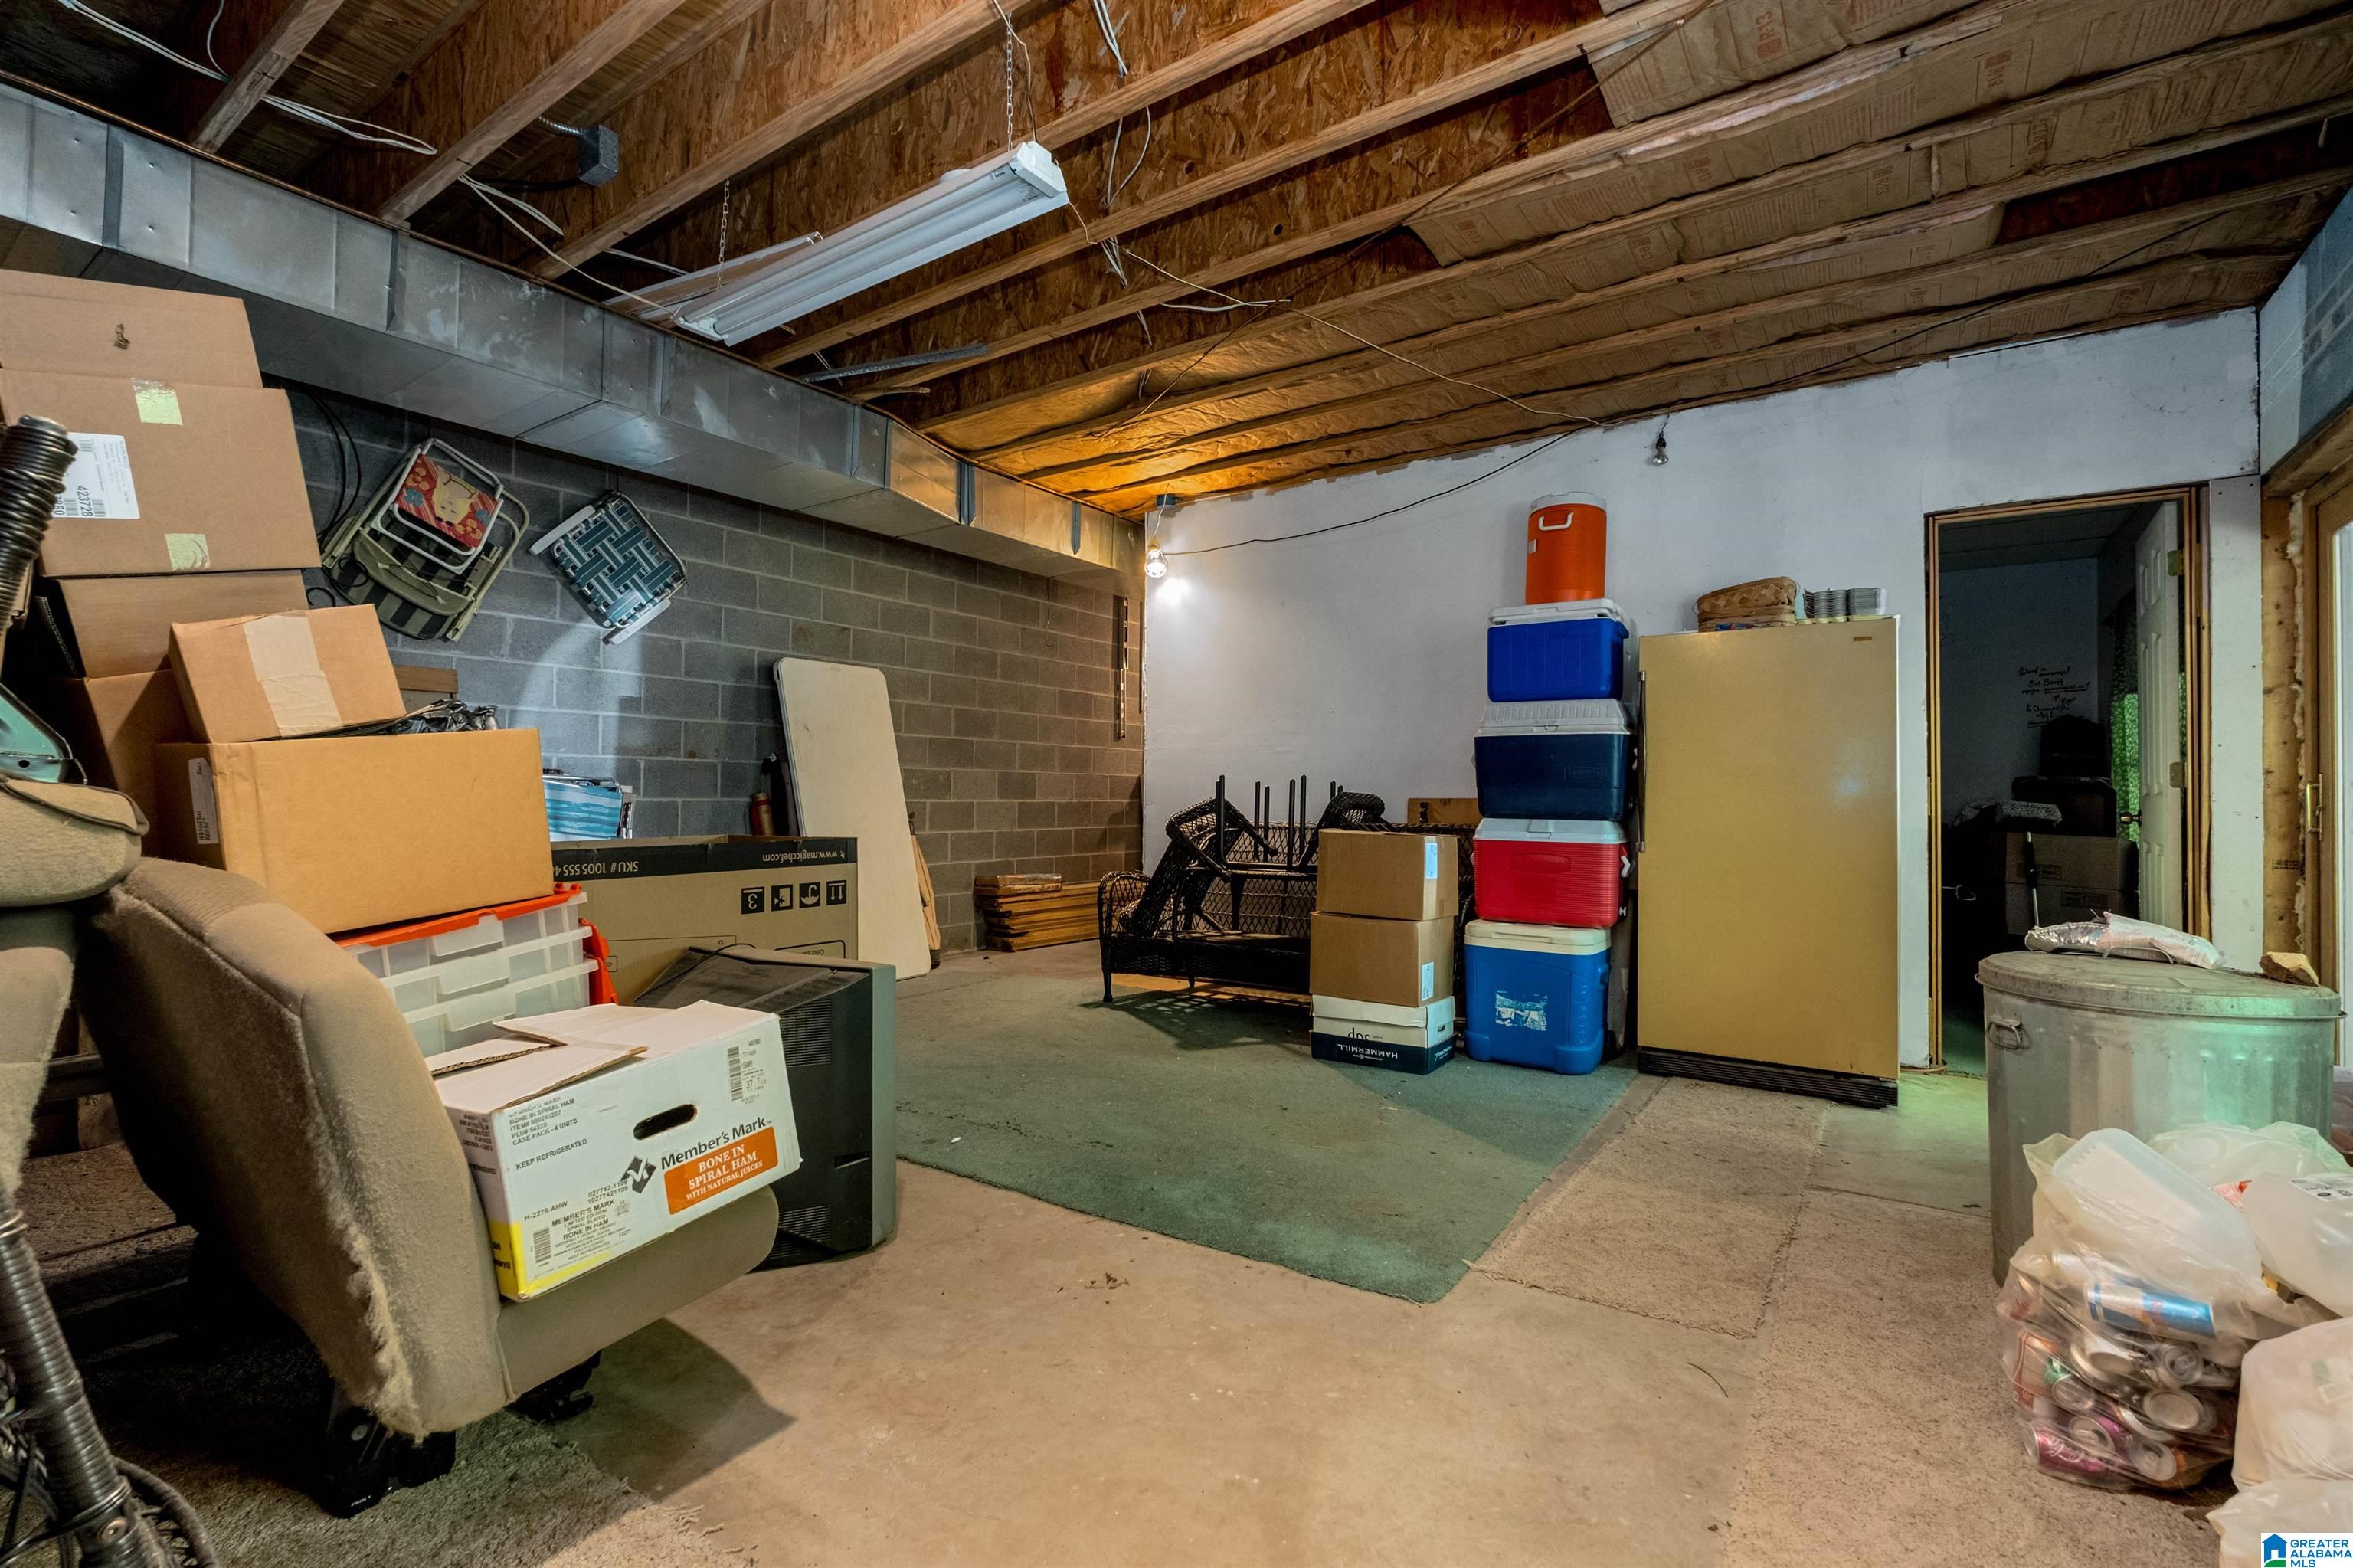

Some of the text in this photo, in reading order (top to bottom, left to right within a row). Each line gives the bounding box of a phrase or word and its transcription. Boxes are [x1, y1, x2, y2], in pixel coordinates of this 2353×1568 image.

[77, 486, 93, 517] 423728
[618, 861, 639, 872] SKU
[763, 849, 839, 863] www.magicchef.com
[1336, 1043, 1399, 1059] HAMMERMILL
[509, 1115, 528, 1124] BONE
[538, 1105, 560, 1115] SPIRAL
[561, 1098, 575, 1108] HAM
[543, 1096, 561, 1106] MARK
[512, 1135, 532, 1146] CASE
[532, 1128, 551, 1139] PACK
[558, 1118, 578, 1129] UNITS
[661, 1117, 766, 1170] Member's Mark
[515, 1157, 535, 1170] KEEP
[536, 1138, 587, 1163] REFRIGERATED
[698, 1144, 745, 1173] BONE IN
[686, 1160, 763, 1201] WITH NATURAL JUICES
[689, 1151, 758, 1190] SPIRAL HAM
[551, 1206, 592, 1227] MEMBER'S
[594, 1199, 615, 1211] MARK
[564, 1216, 586, 1229] LIMITED
[586, 1208, 607, 1219] EDITION
[566, 1213, 606, 1232] SPIRAL SLICED
[563, 1229, 584, 1240] BONE
[593, 1218, 609, 1229] HAM
